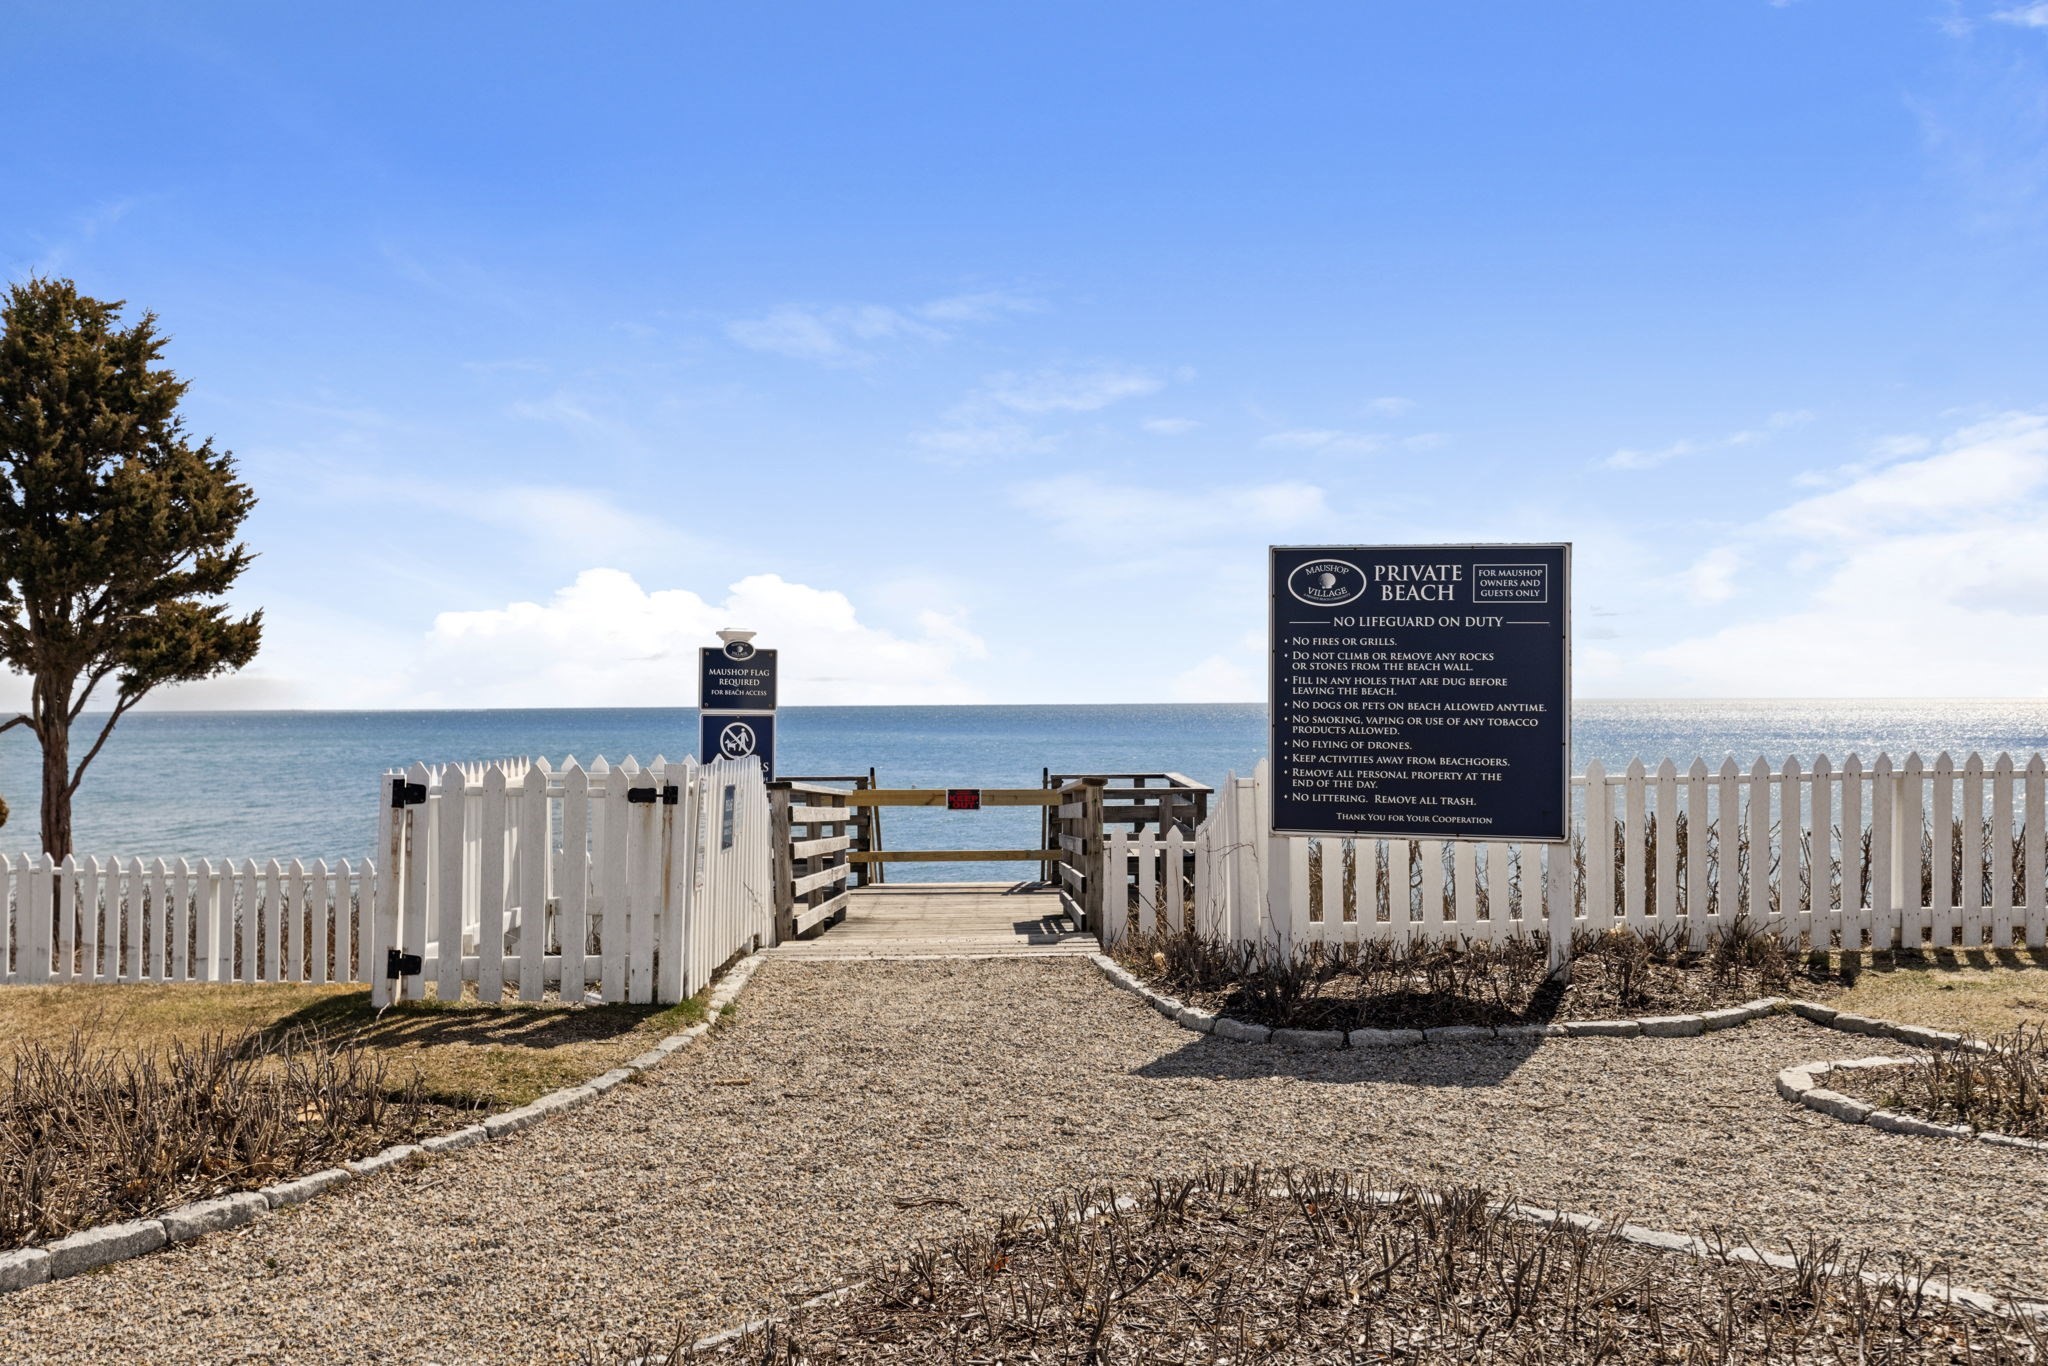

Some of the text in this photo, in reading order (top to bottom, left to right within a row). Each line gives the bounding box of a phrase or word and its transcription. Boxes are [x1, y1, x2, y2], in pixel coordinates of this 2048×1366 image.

[1305, 564, 1349, 575] MAUSHOP
[1375, 565, 1463, 582] PRIVATE
[1308, 586, 1348, 598] VILLAGE
[1382, 585, 1455, 601] BEACH
[1334, 617, 1504, 627] NO LIFEGUARD ON DUTY
[1313, 638, 1340, 646] FIRES
[1342, 638, 1358, 646] OR
[1360, 638, 1398, 646] GRILLS.
[1338, 653, 1370, 661] CLIMB
[1372, 653, 1388, 661] OR
[1391, 653, 1432, 661] REMOVE
[1435, 653, 1457, 661] ANY
[1460, 653, 1495, 661] ROCKS
[1310, 663, 1348, 671] STONES
[1352, 663, 1380, 671] FROM
[1383, 663, 1404, 671] THE
[1408, 663, 1441, 671] BEACH
[751, 669, 770, 677] FLAG
[720, 679, 761, 687] REQUIRED
[1390, 678, 1417, 686] THAT
[1420, 678, 1439, 686] ARE
[1443, 678, 1466, 686] DUG
[1470, 678, 1508, 687] BEFORE
[1293, 687, 1397, 696] LEAVING THE BEACH.
[1313, 702, 1342, 710] DOGS
[1344, 702, 1360, 710] OR
[1363, 702, 1385, 710] PETS
[1408, 703, 1441, 711] BEACH
[1444, 703, 1495, 712] ALLOWED
[1497, 704, 1547, 712] ANYTIME.
[1313, 716, 1364, 726] SMOKING,
[1366, 717, 1404, 725] VAPING
[1426, 718, 1444, 726] USE
[1447, 718, 1461, 726] OF
[1463, 718, 1485, 726] ANY
[1488, 719, 1539, 727] TOBACCO
[1293, 726, 1400, 735] PRODUCTS ALLOWED.
[1313, 741, 1348, 749] FLYING
[1368, 742, 1413, 750] DRONES.
[1319, 756, 1374, 764] ACTIVITIES
[1377, 757, 1404, 765] AWAY
[1407, 757, 1437, 765] FROM
[1440, 758, 1510, 767] BEACHGOERS.
[1358, 771, 1409, 779] PERSONAL
[1412, 772, 1463, 780] PROPERTY
[1466, 773, 1478, 781] AT
[1481, 773, 1502, 781] THE
[1293, 779, 1314, 787] END
[1317, 780, 1331, 788] OF
[1357, 781, 1378, 789] DAY.
[1313, 795, 1369, 803] LITTERING.
[1420, 797, 1438, 805] ALL
[1440, 798, 1477, 806] TRASH.
